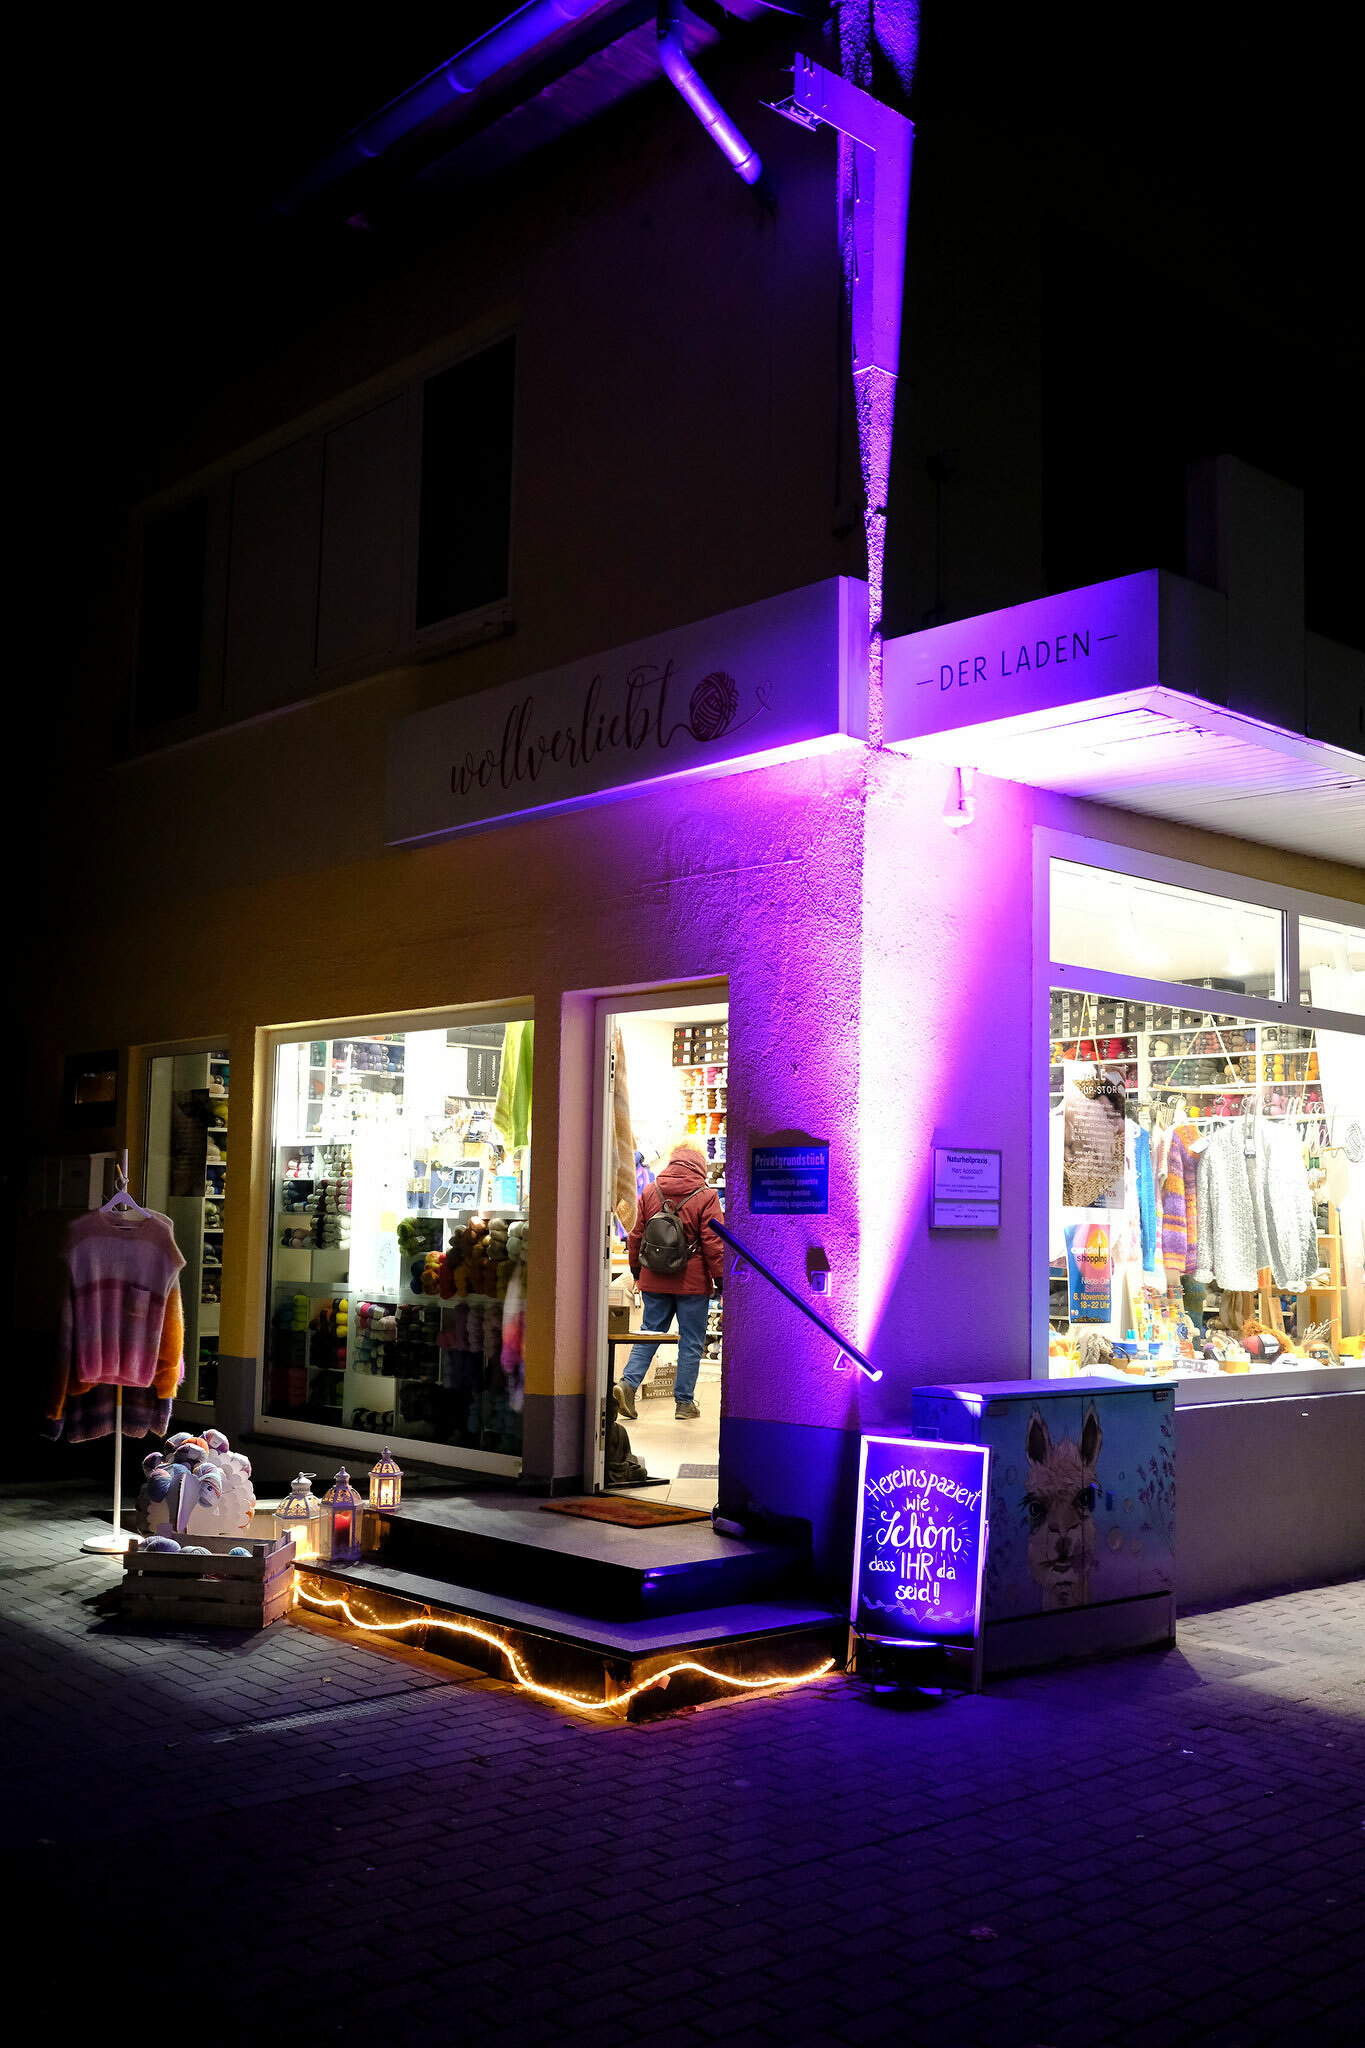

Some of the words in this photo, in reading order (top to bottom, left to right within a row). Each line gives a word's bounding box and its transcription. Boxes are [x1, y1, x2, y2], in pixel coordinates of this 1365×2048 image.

[940, 656, 987, 691] DER
[1001, 629, 1090, 676] LADEN
[450, 659, 679, 795] wollverliebt
[1079, 1068, 1106, 1081] ALE
[755, 1152, 825, 1169] Privatgrundstück
[946, 1155, 988, 1165] Naturheilpraxis
[1076, 1254, 1107, 1264] shopping
[1080, 1292, 1110, 1301] November
[1100, 1301, 1110, 1309] Uhr
[864, 1464, 982, 1511] Hereinspaziert
[905, 1493, 931, 1511] wie
[876, 1510, 962, 1552] Schön
[868, 1554, 896, 1572] dass
[900, 1551, 932, 1581] IHR
[936, 1559, 956, 1580] da
[895, 1581, 940, 1606] seid!
